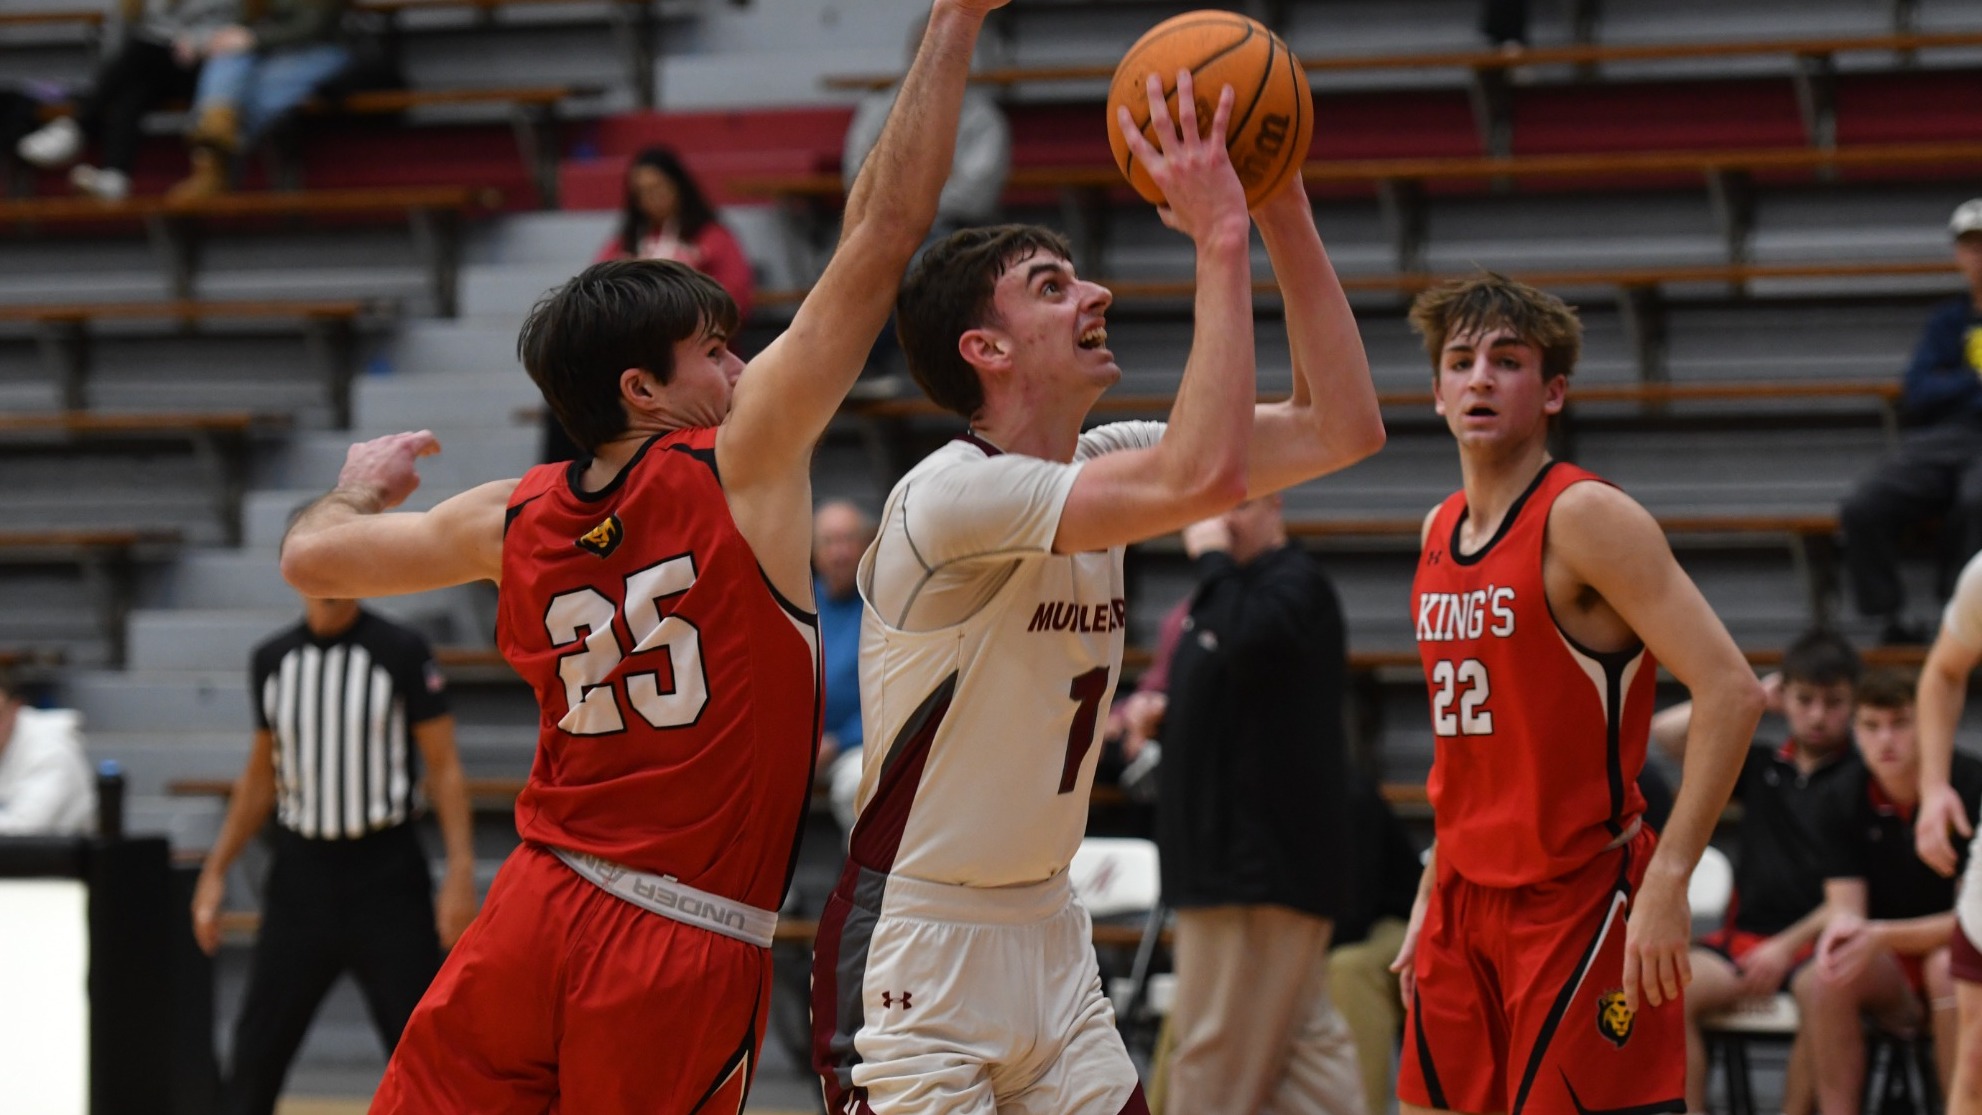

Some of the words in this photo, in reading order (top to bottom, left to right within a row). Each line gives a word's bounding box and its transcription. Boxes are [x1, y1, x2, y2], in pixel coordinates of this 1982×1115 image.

[543, 551, 711, 738] 25
[1415, 583, 1516, 642] KING'S
[1057, 664, 1110, 795] 1
[1432, 657, 1494, 737] 22
[633, 877, 745, 930] UNDER
